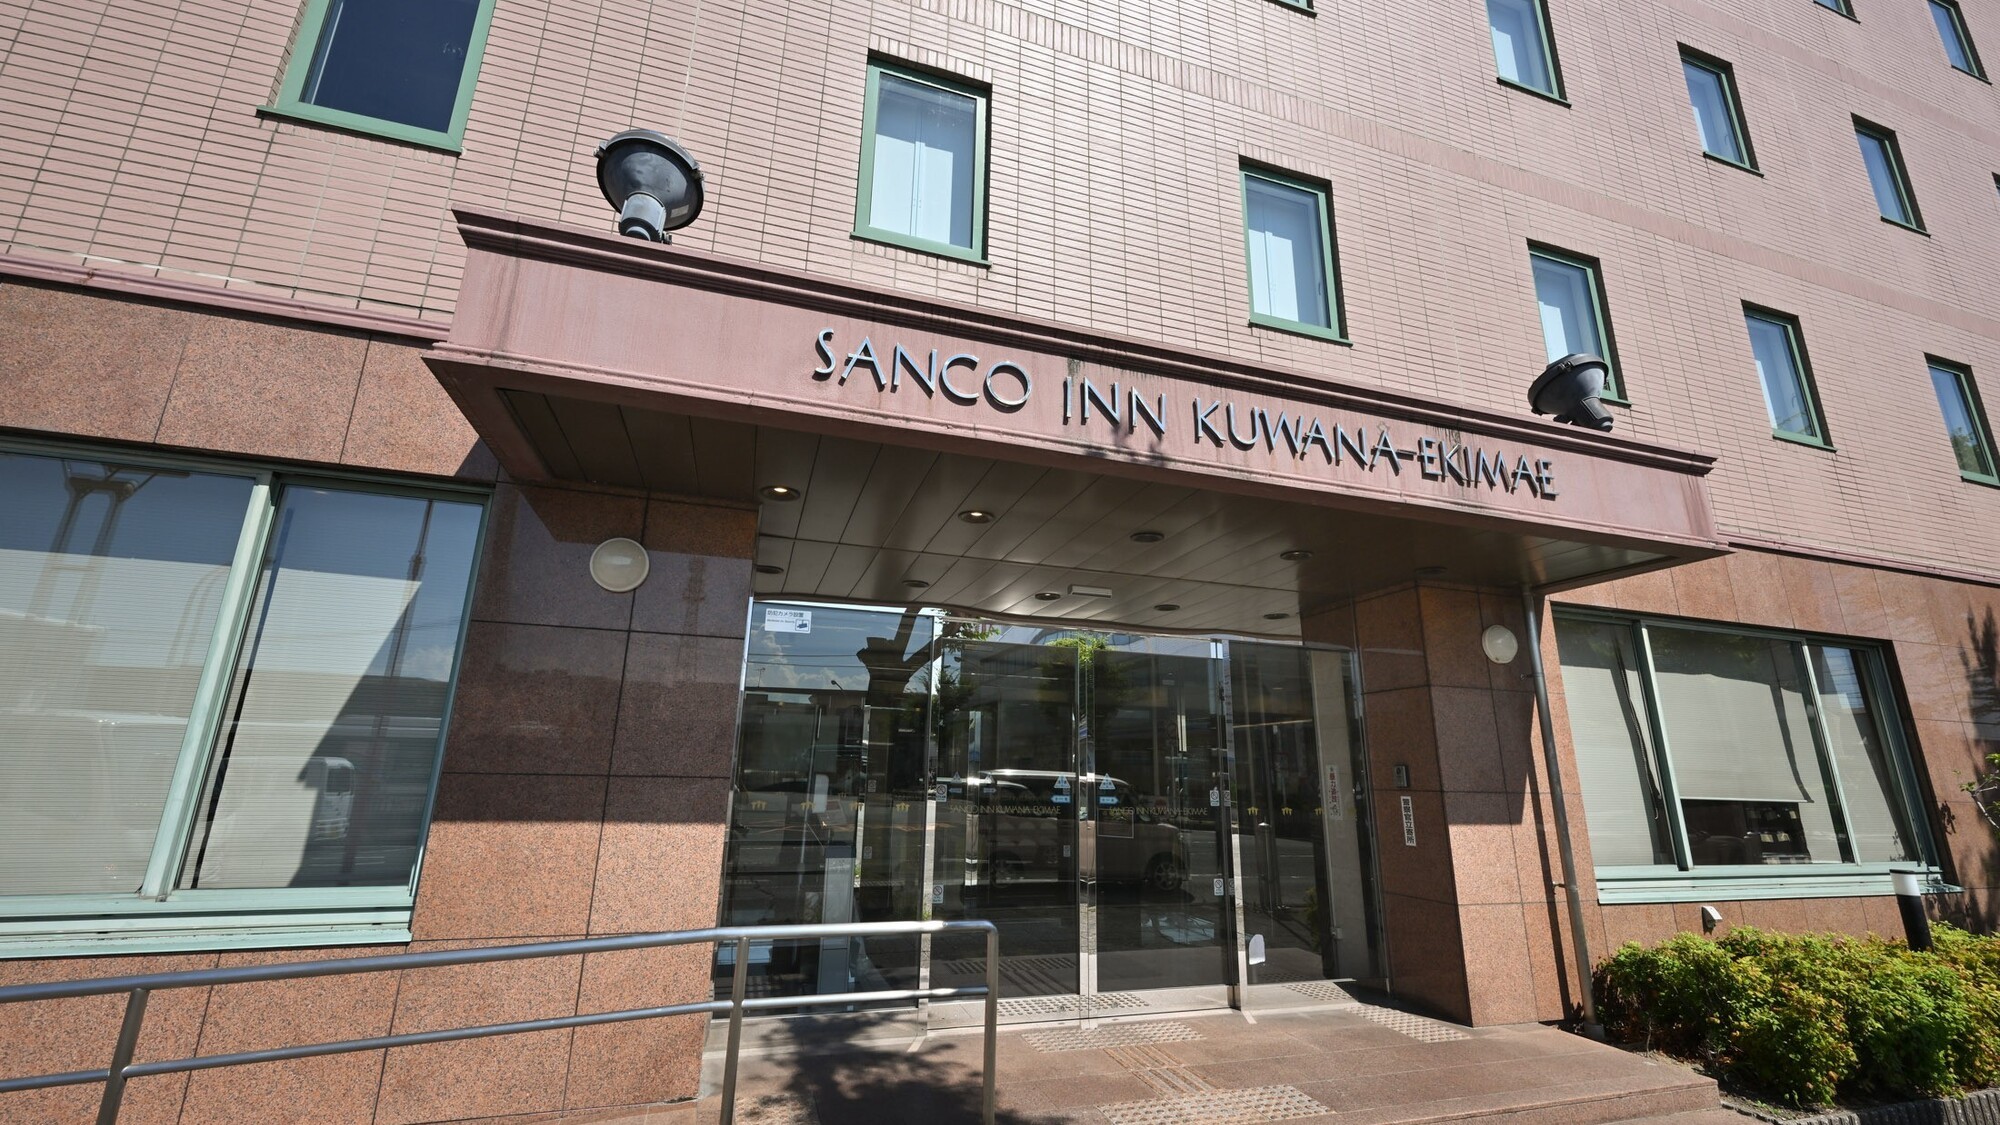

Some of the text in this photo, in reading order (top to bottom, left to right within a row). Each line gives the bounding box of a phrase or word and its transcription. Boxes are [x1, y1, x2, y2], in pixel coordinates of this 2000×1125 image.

[815, 328, 1560, 496] SANCO INN KUWANA-EKIMAE
[767, 610, 804, 618] 防犯カメラ設置
[1402, 798, 1415, 844] 警察官立寄所
